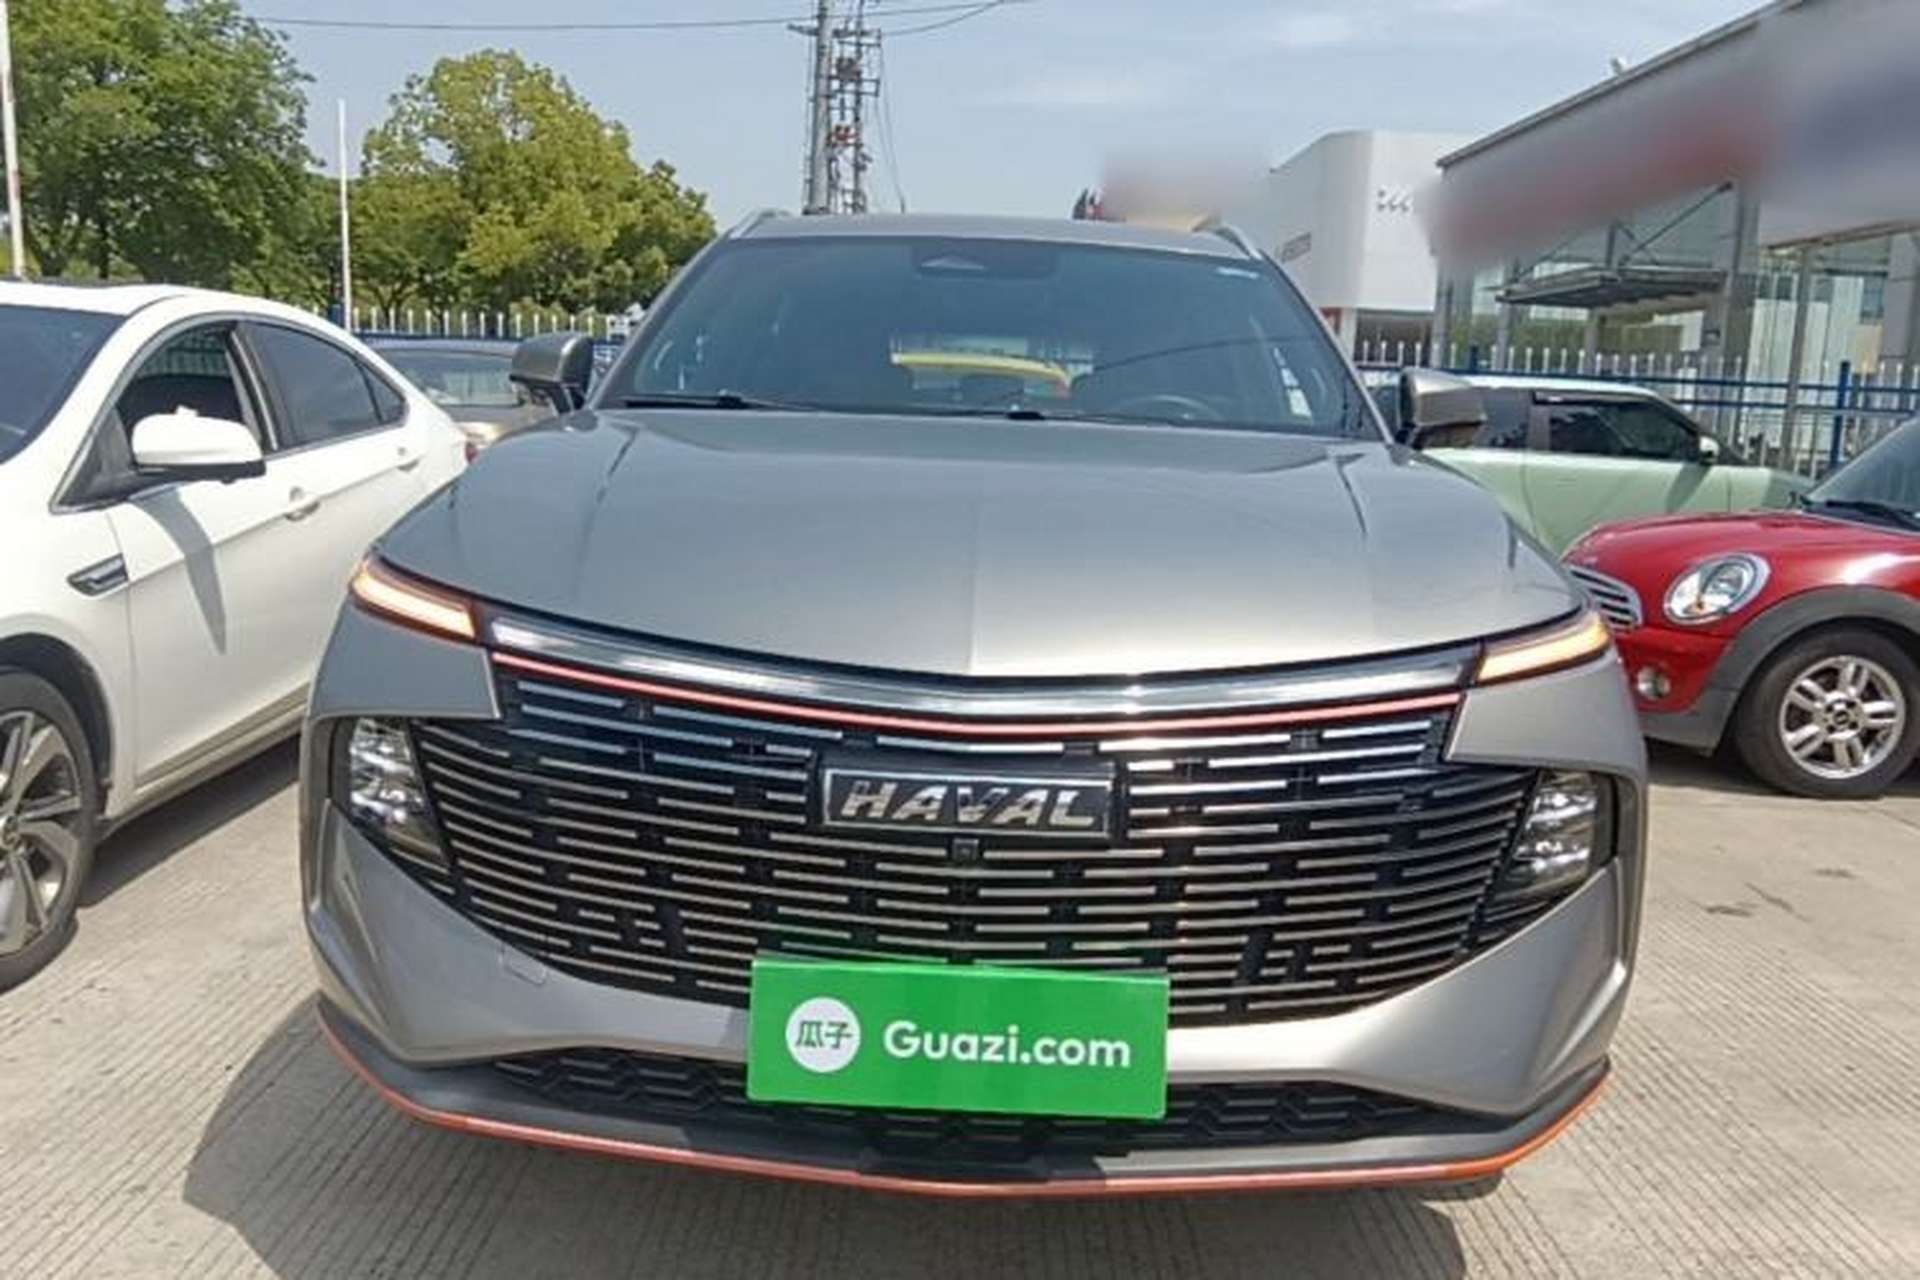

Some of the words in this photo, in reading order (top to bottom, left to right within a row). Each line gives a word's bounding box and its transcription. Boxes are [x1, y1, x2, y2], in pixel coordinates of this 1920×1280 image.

[841, 780, 1095, 826] HAVAL
[796, 1019, 853, 1049] 瓜子
[883, 1020, 1131, 1067] Guazi.com
